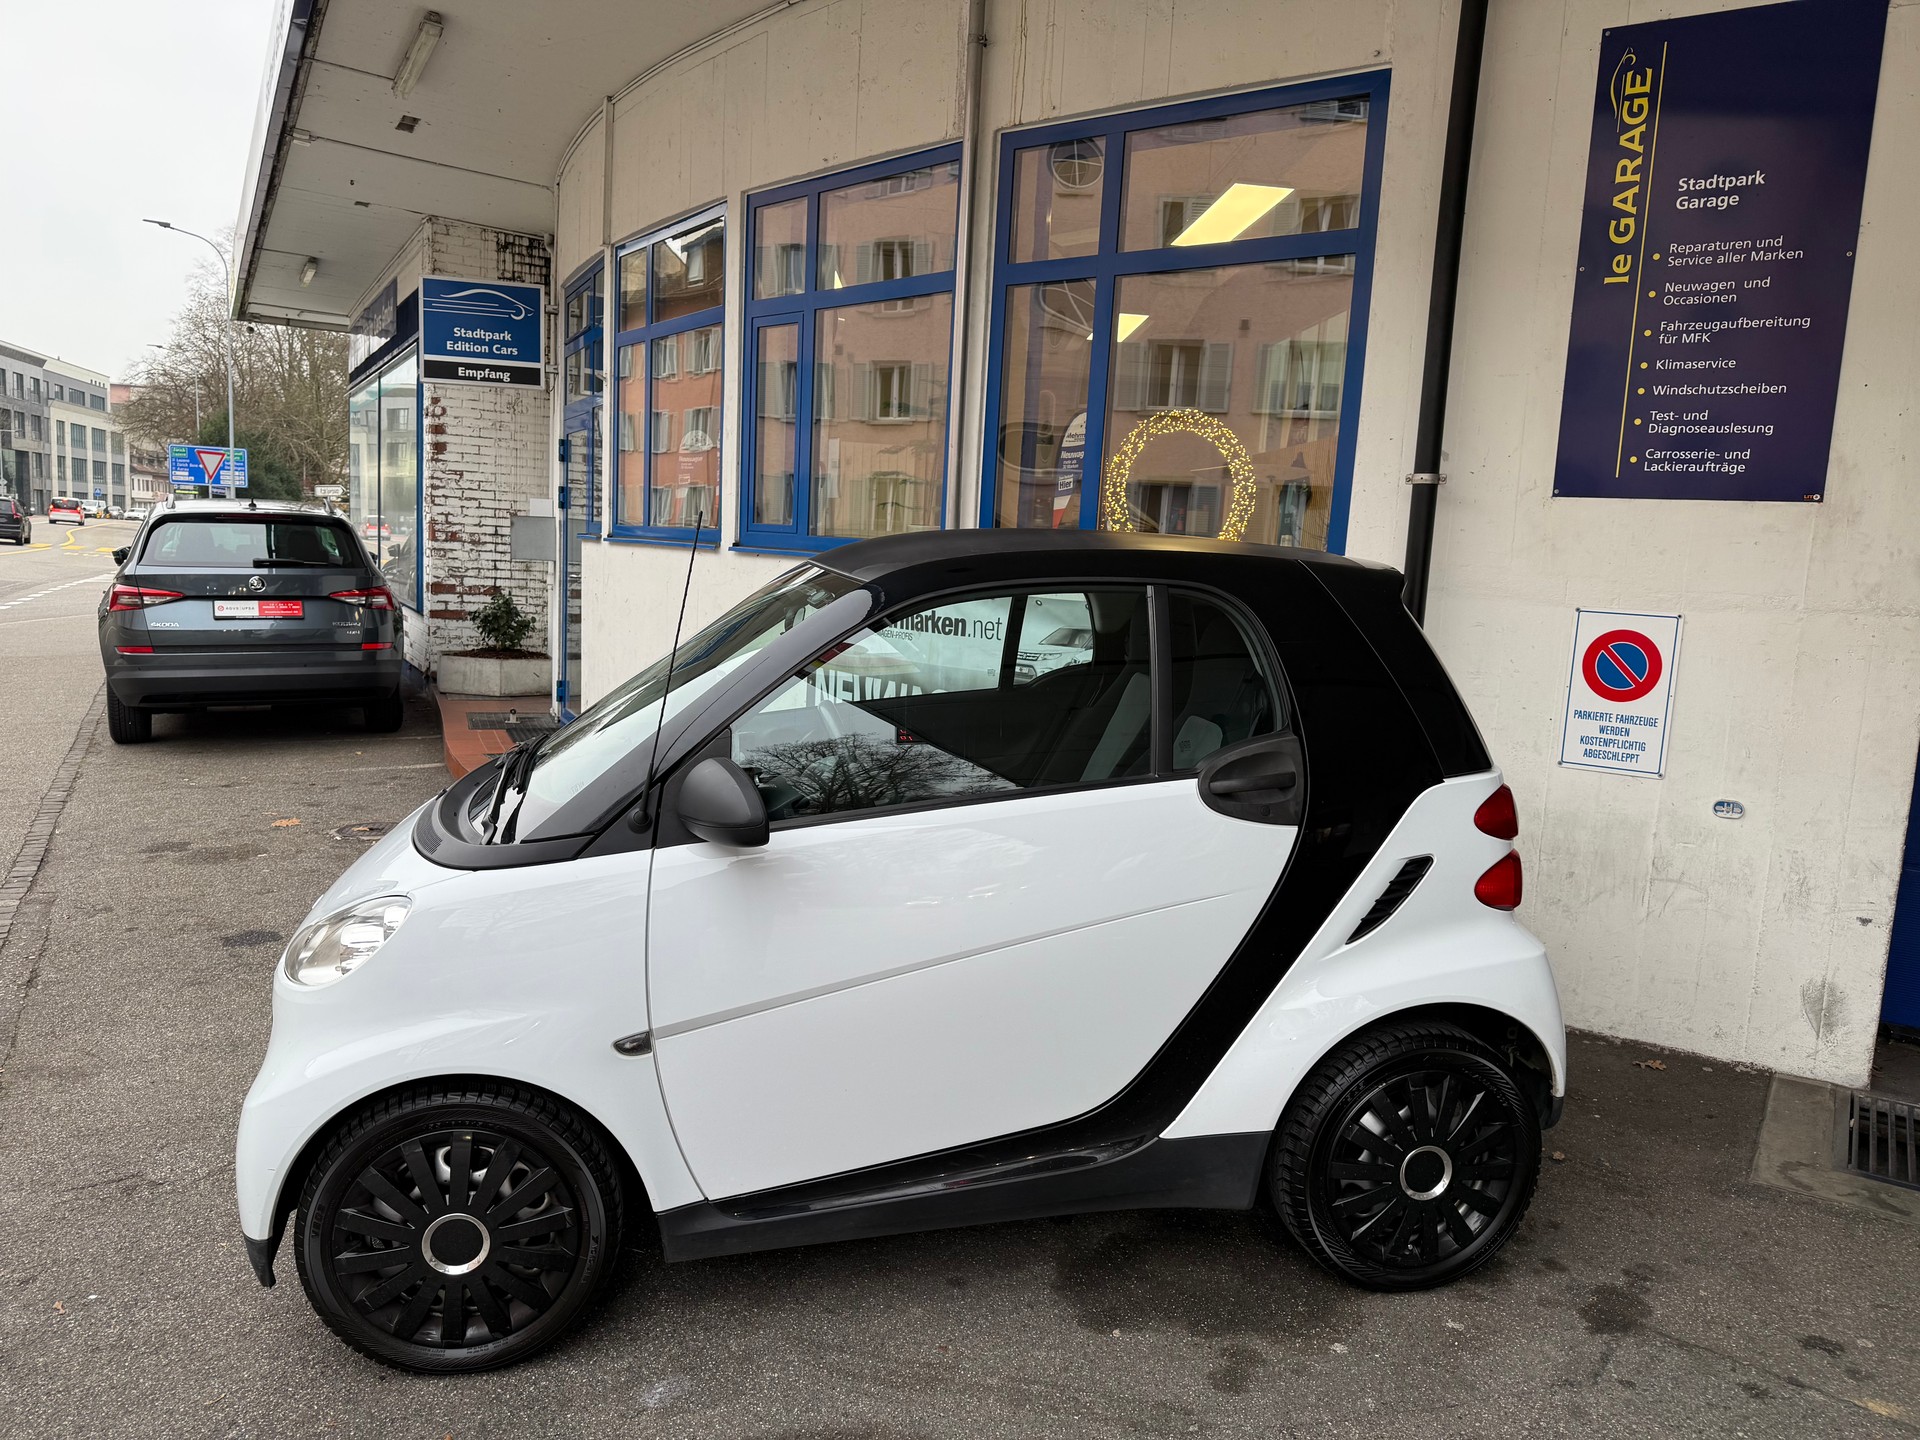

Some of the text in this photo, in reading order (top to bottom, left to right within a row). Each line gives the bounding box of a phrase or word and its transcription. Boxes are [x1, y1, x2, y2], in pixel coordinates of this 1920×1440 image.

[1604, 66, 1653, 285] le GARAGE
[1677, 170, 1766, 192] Stadtpark
[1675, 192, 1740, 211] Garage
[1669, 235, 1783, 255] Reparaturen und
[1668, 248, 1804, 267] Service aller Marken
[1664, 276, 1771, 294] Neuwagen und
[1663, 292, 1737, 306] Occasionen
[1660, 315, 1811, 332] Fahrzeugaufbereitung
[454, 327, 512, 342] Stadtpark
[1658, 331, 1712, 344] für MFK
[446, 341, 518, 356] Edition Cars
[1656, 357, 1737, 370] Klimaservice
[458, 366, 511, 382] Empfang
[1652, 382, 1787, 396] Windschutzscheiben
[1650, 409, 1708, 422] Test- und
[1648, 422, 1774, 436] Diagnoseauslesung
[1644, 448, 1751, 460] Carrosserie- und
[1644, 460, 1746, 474] Lackieraufträge
[1060, 481, 1072, 489] Hier
[1574, 709, 1658, 727] PARKIERTE FAHRZEUGE
[1599, 725, 1630, 737] WERDEN
[1579, 736, 1646, 752] KOSTENPFLICHTIG
[1583, 748, 1640, 763] ABGESCHLEPPT
